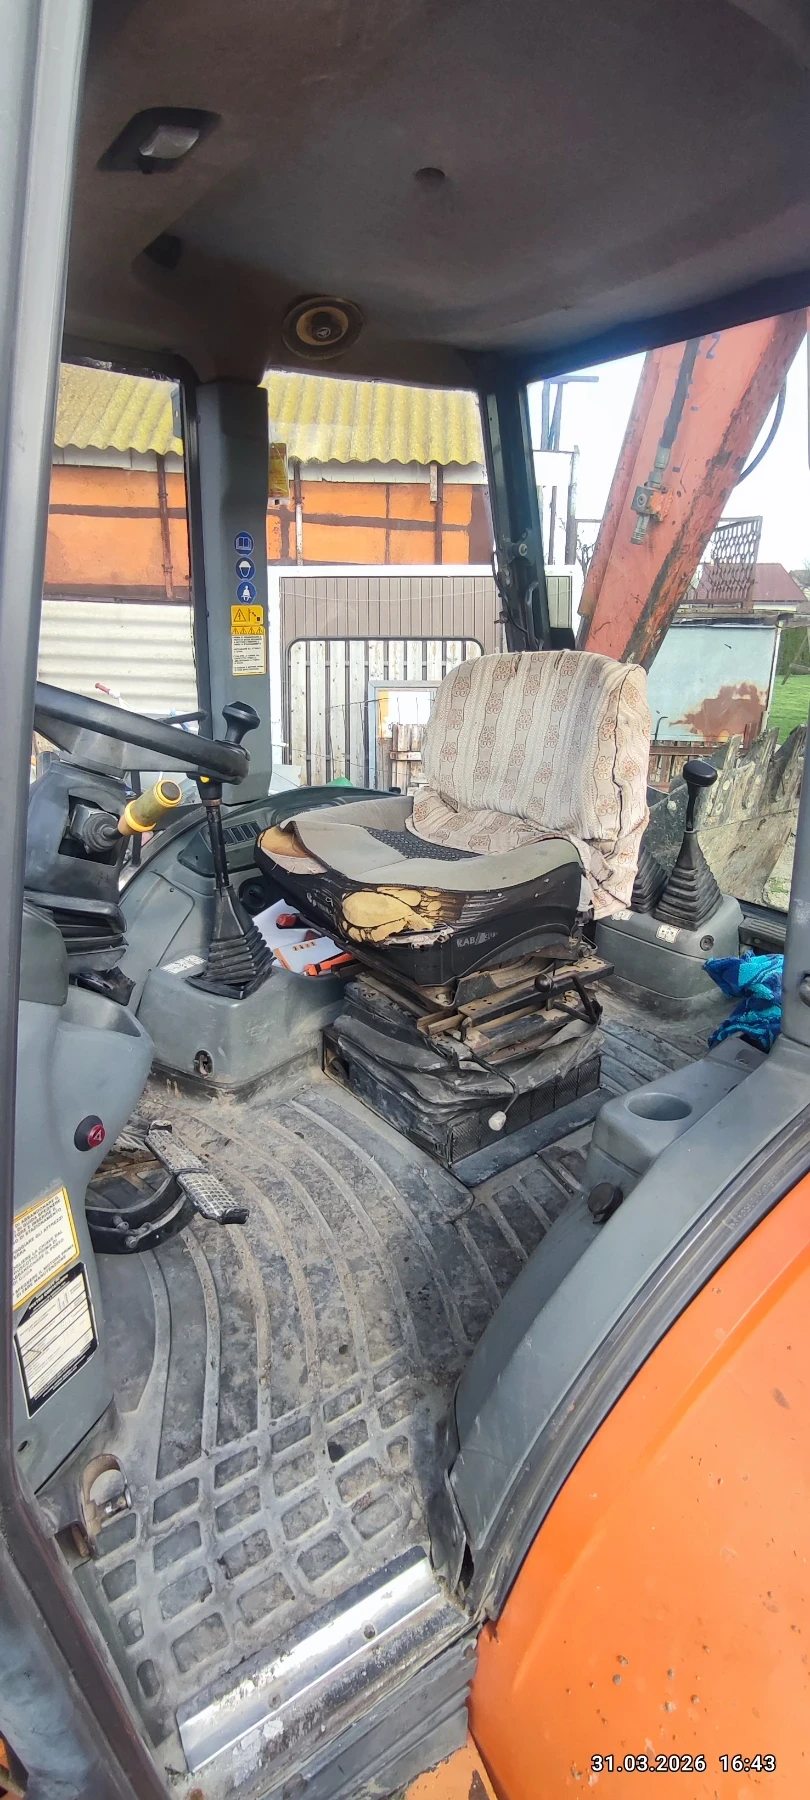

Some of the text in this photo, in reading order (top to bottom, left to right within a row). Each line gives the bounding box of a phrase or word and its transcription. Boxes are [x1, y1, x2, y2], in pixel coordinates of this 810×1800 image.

[21, 1199, 54, 1224] ABBANDONARE
[23, 1216, 37, 1228] GUIDA
[38, 1199, 61, 1217] SPEGNERE
[31, 1211, 52, 1226] INSERIRE
[25, 1208, 62, 1236] STAZIONAMENTO
[43, 1215, 64, 1233] ATTREZZI
[38, 1237, 54, 1250] CHIAVE
[38, 1243, 52, 1255] PRIMA
[50, 1238, 64, 1251] POSTO
[13, 1249, 26, 1260] ERRA
[43, 1254, 61, 1270] MOTORE
[33, 1254, 66, 1283] MANUTENZIONE
